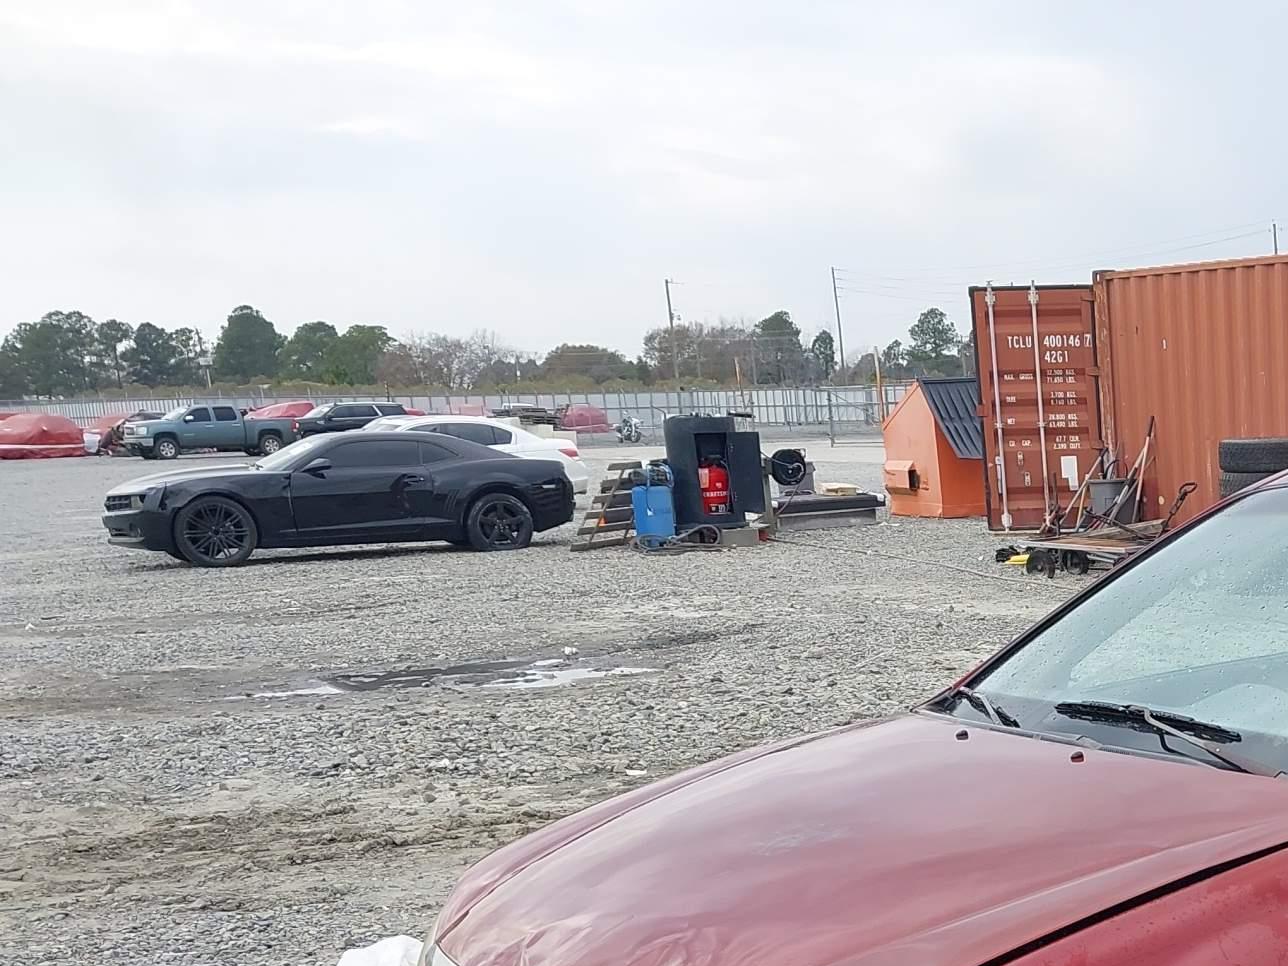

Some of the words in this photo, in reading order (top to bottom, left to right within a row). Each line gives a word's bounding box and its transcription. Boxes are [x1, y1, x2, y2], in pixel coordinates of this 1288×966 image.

[1007, 336, 1032, 349] TCLU
[1043, 334, 1081, 348] 400146
[1044, 350, 1069, 363] 42G1
